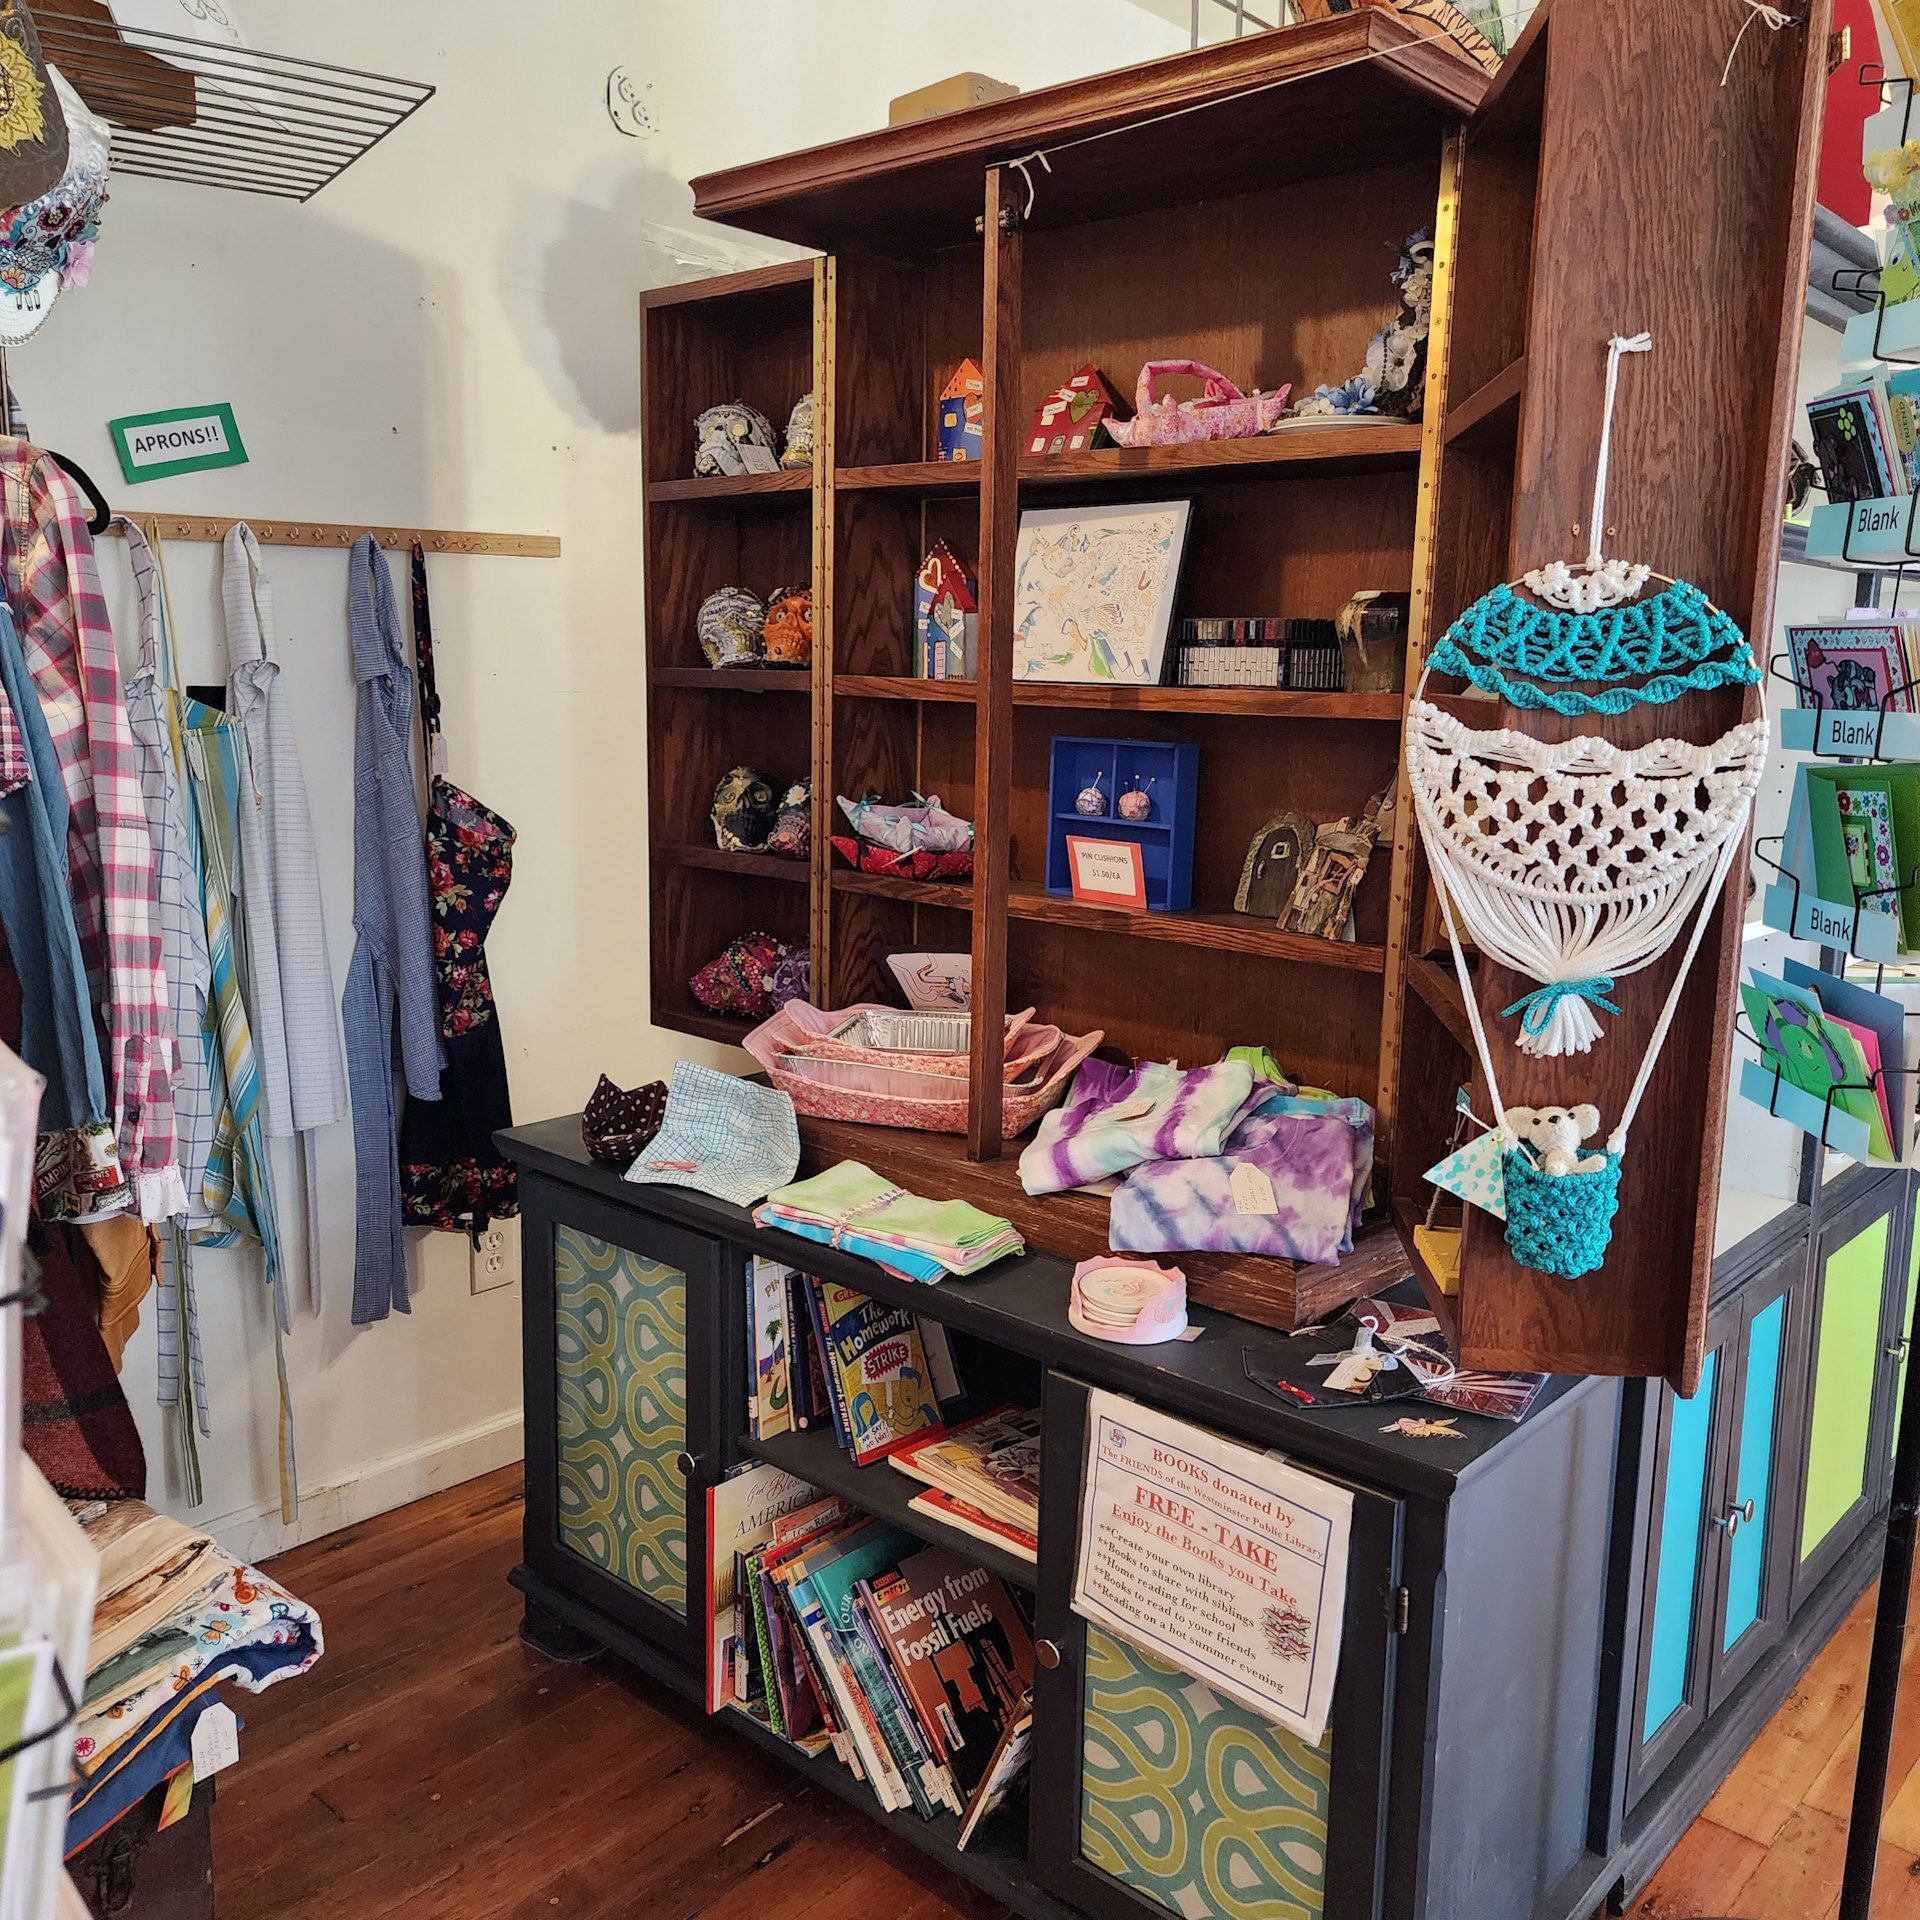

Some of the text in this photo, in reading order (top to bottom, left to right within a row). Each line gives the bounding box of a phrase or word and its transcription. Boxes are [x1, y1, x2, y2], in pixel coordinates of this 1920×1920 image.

[135, 426, 219, 453] APRONS!!
[1899, 401, 1912, 446] FRIEND
[1858, 505, 1900, 533] Blank
[1832, 720, 1874, 746] Blank
[1081, 851, 1128, 865] PIN CUSHIONS
[1092, 868, 1122, 881] $1.50/EA
[1811, 907, 1851, 942] Blank
[840, 1308, 911, 1361] Homework
[858, 1301, 884, 1324] The
[867, 1345, 907, 1375] STRIKE
[828, 1351, 844, 1400] Homework
[838, 1401, 851, 1433] STRIKE
[734, 1486, 815, 1540] AMERICA
[1102, 1445, 1323, 1559] The FRIENDS of the Westminster Public Library
[1152, 1448, 1295, 1529] BOOKS donated by
[815, 1508, 837, 1528] Read!
[1134, 1485, 1195, 1529] FREE
[1214, 1523, 1278, 1573] TAKE
[1111, 1502, 1298, 1607] Enjoy the Books you Take
[1146, 1549, 1170, 1567] your
[1172, 1564, 1195, 1580] own
[1198, 1573, 1236, 1603] library
[841, 1594, 853, 1623] OUR
[880, 1588, 948, 1635] Energy
[943, 1567, 990, 1600] from
[1137, 1577, 1179, 1606] reading
[1180, 1597, 1198, 1612] for
[1200, 1608, 1237, 1633] school
[1139, 1562, 1150, 1573] to
[1152, 1569, 1182, 1590] share
[1185, 1585, 1210, 1603] with
[1211, 1598, 1255, 1628] siblings
[895, 1619, 951, 1667] Fossil
[944, 1600, 994, 1640] Fuels
[1134, 1591, 1145, 1602] to
[1147, 1599, 1172, 1616] read
[1174, 1612, 1186, 1623] to
[1187, 1619, 1214, 1637] your
[1216, 1631, 1257, 1660] friends
[1143, 1613, 1157, 1625] on
[1159, 1621, 1166, 1630] a
[1168, 1623, 1188, 1640] hot
[1188, 1635, 1237, 1666] summer
[1239, 1660, 1285, 1695] evening
